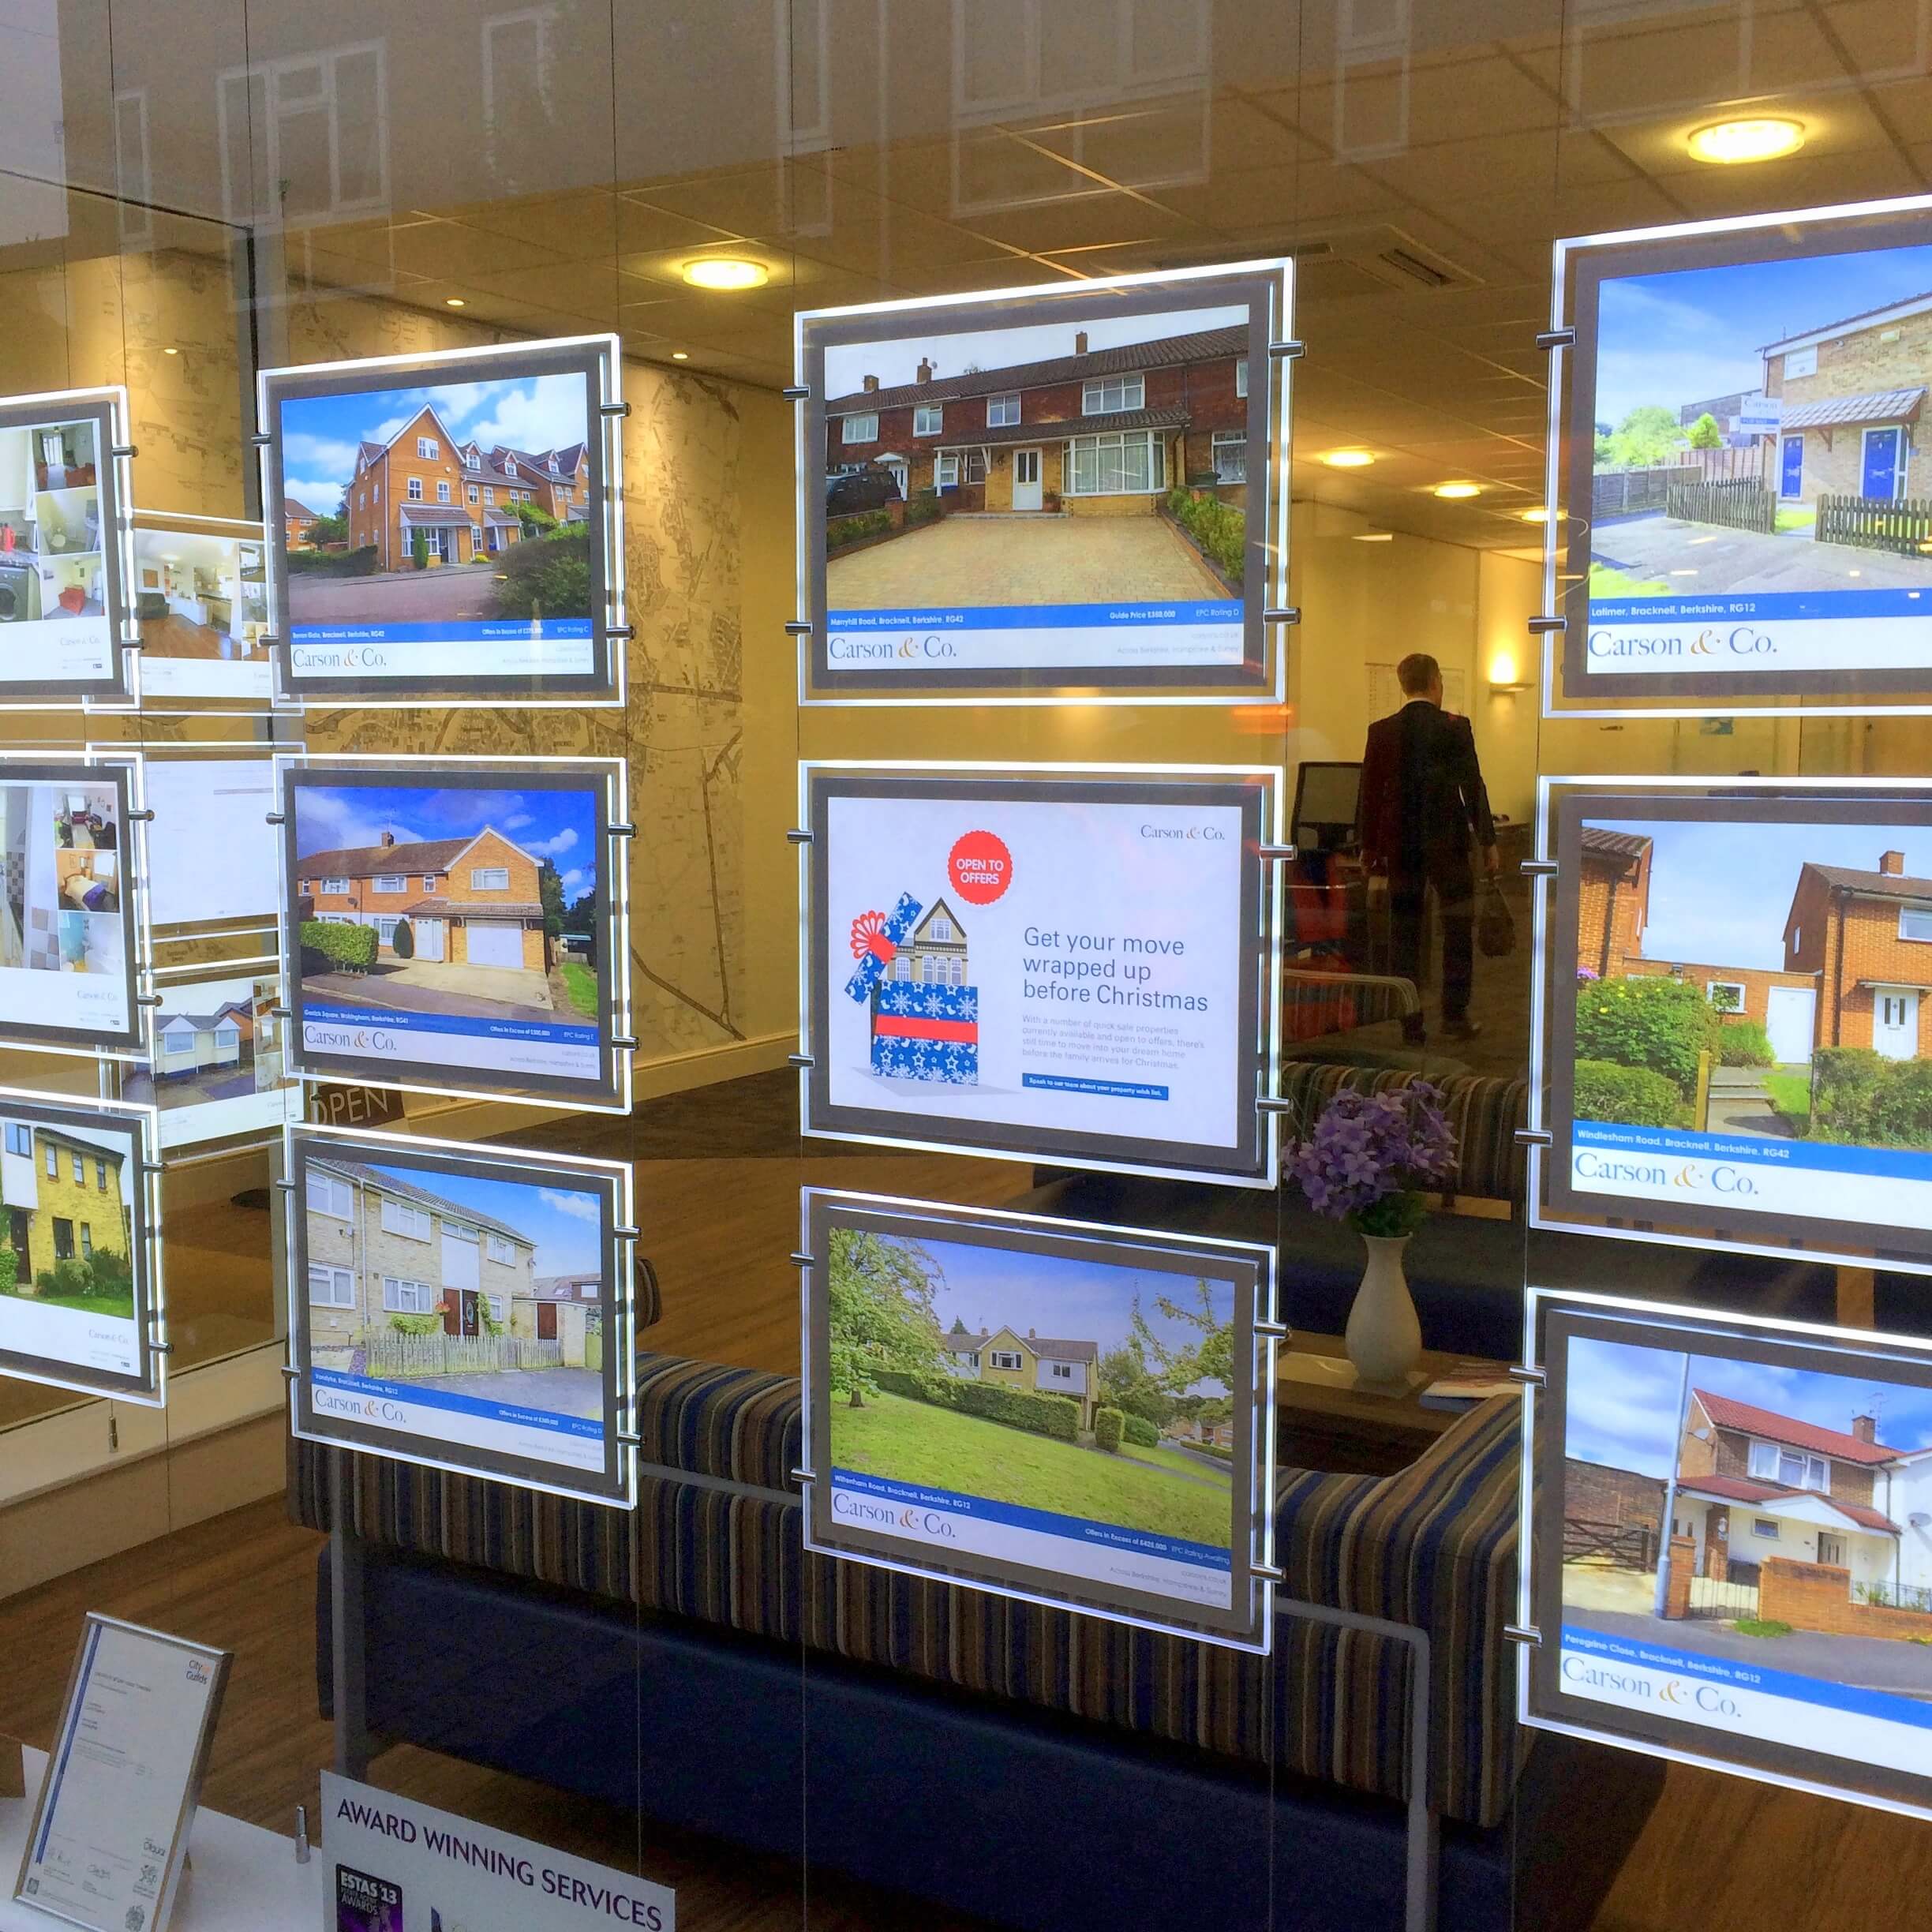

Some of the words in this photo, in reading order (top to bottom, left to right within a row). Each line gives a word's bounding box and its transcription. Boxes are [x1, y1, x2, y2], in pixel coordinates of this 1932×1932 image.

[1592, 608, 1628, 616] Latimer,
[1631, 606, 1676, 616] Bracknell,
[1680, 604, 1726, 614] Berkshire,
[1730, 603, 1756, 612] RG12
[829, 638, 893, 659] Carson
[898, 637, 919, 658] &
[924, 635, 957, 658] Co.
[1589, 631, 1682, 657] Carson
[1690, 630, 1720, 655] &
[1729, 627, 1777, 655] Co.
[293, 649, 339, 667] Carson
[344, 649, 358, 667] &
[362, 648, 387, 667] Co.
[1140, 824, 1184, 840] Carson
[1204, 826, 1225, 841] Co.
[957, 858, 987, 871] OPEN
[988, 859, 1004, 872] TO
[960, 872, 999, 885] OFFERS
[1024, 927, 1060, 948] Get
[1066, 934, 1115, 953] your
[1123, 938, 1185, 956] move
[1023, 957, 1115, 980] wrapped
[1124, 964, 1151, 984] up
[1024, 979, 1091, 1002] before
[1097, 984, 1208, 1012] Christmas
[305, 1025, 350, 1046] Carson
[354, 1031, 369, 1048] &
[373, 1032, 397, 1050] Co.
[1022, 1016, 1040, 1024] With
[1050, 1017, 1081, 1028] number
[1084, 1019, 1091, 1028] of
[1094, 1020, 1114, 1030] quick
[1117, 1022, 1133, 1032] sale
[1136, 1024, 1178, 1036] properties
[1022, 1028, 1057, 1038] currently
[1059, 1029, 1095, 1040] available
[1097, 1032, 1112, 1042] and
[1114, 1035, 1135, 1044] open
[1137, 1035, 1146, 1044] to
[1578, 1129, 1633, 1144] Windlesham
[1763, 1147, 1789, 1159] RG42
[1574, 1152, 1666, 1185] Carson
[1674, 1164, 1704, 1189] &
[1711, 1166, 1758, 1195] Co.
[315, 1389, 361, 1415] Carson
[365, 1400, 379, 1418] &
[382, 1402, 406, 1423] Co.
[833, 1492, 894, 1524] Carson
[900, 1509, 919, 1530] &
[924, 1513, 956, 1538] Co.
[953, 1500, 971, 1510] RG12
[1565, 1634, 1608, 1650] Peregrine
[1735, 1671, 1762, 1684] RG12
[1563, 1657, 1650, 1698] Carson
[1659, 1679, 1688, 1705] &
[1696, 1686, 1742, 1717] Co.
[337, 1798, 416, 1844] AWARD
[423, 1826, 534, 1887] WINNING
[541, 1869, 663, 1931] SERVICES
[341, 1870, 378, 1897] ESTAS
[342, 1893, 378, 1915] AWARDS
